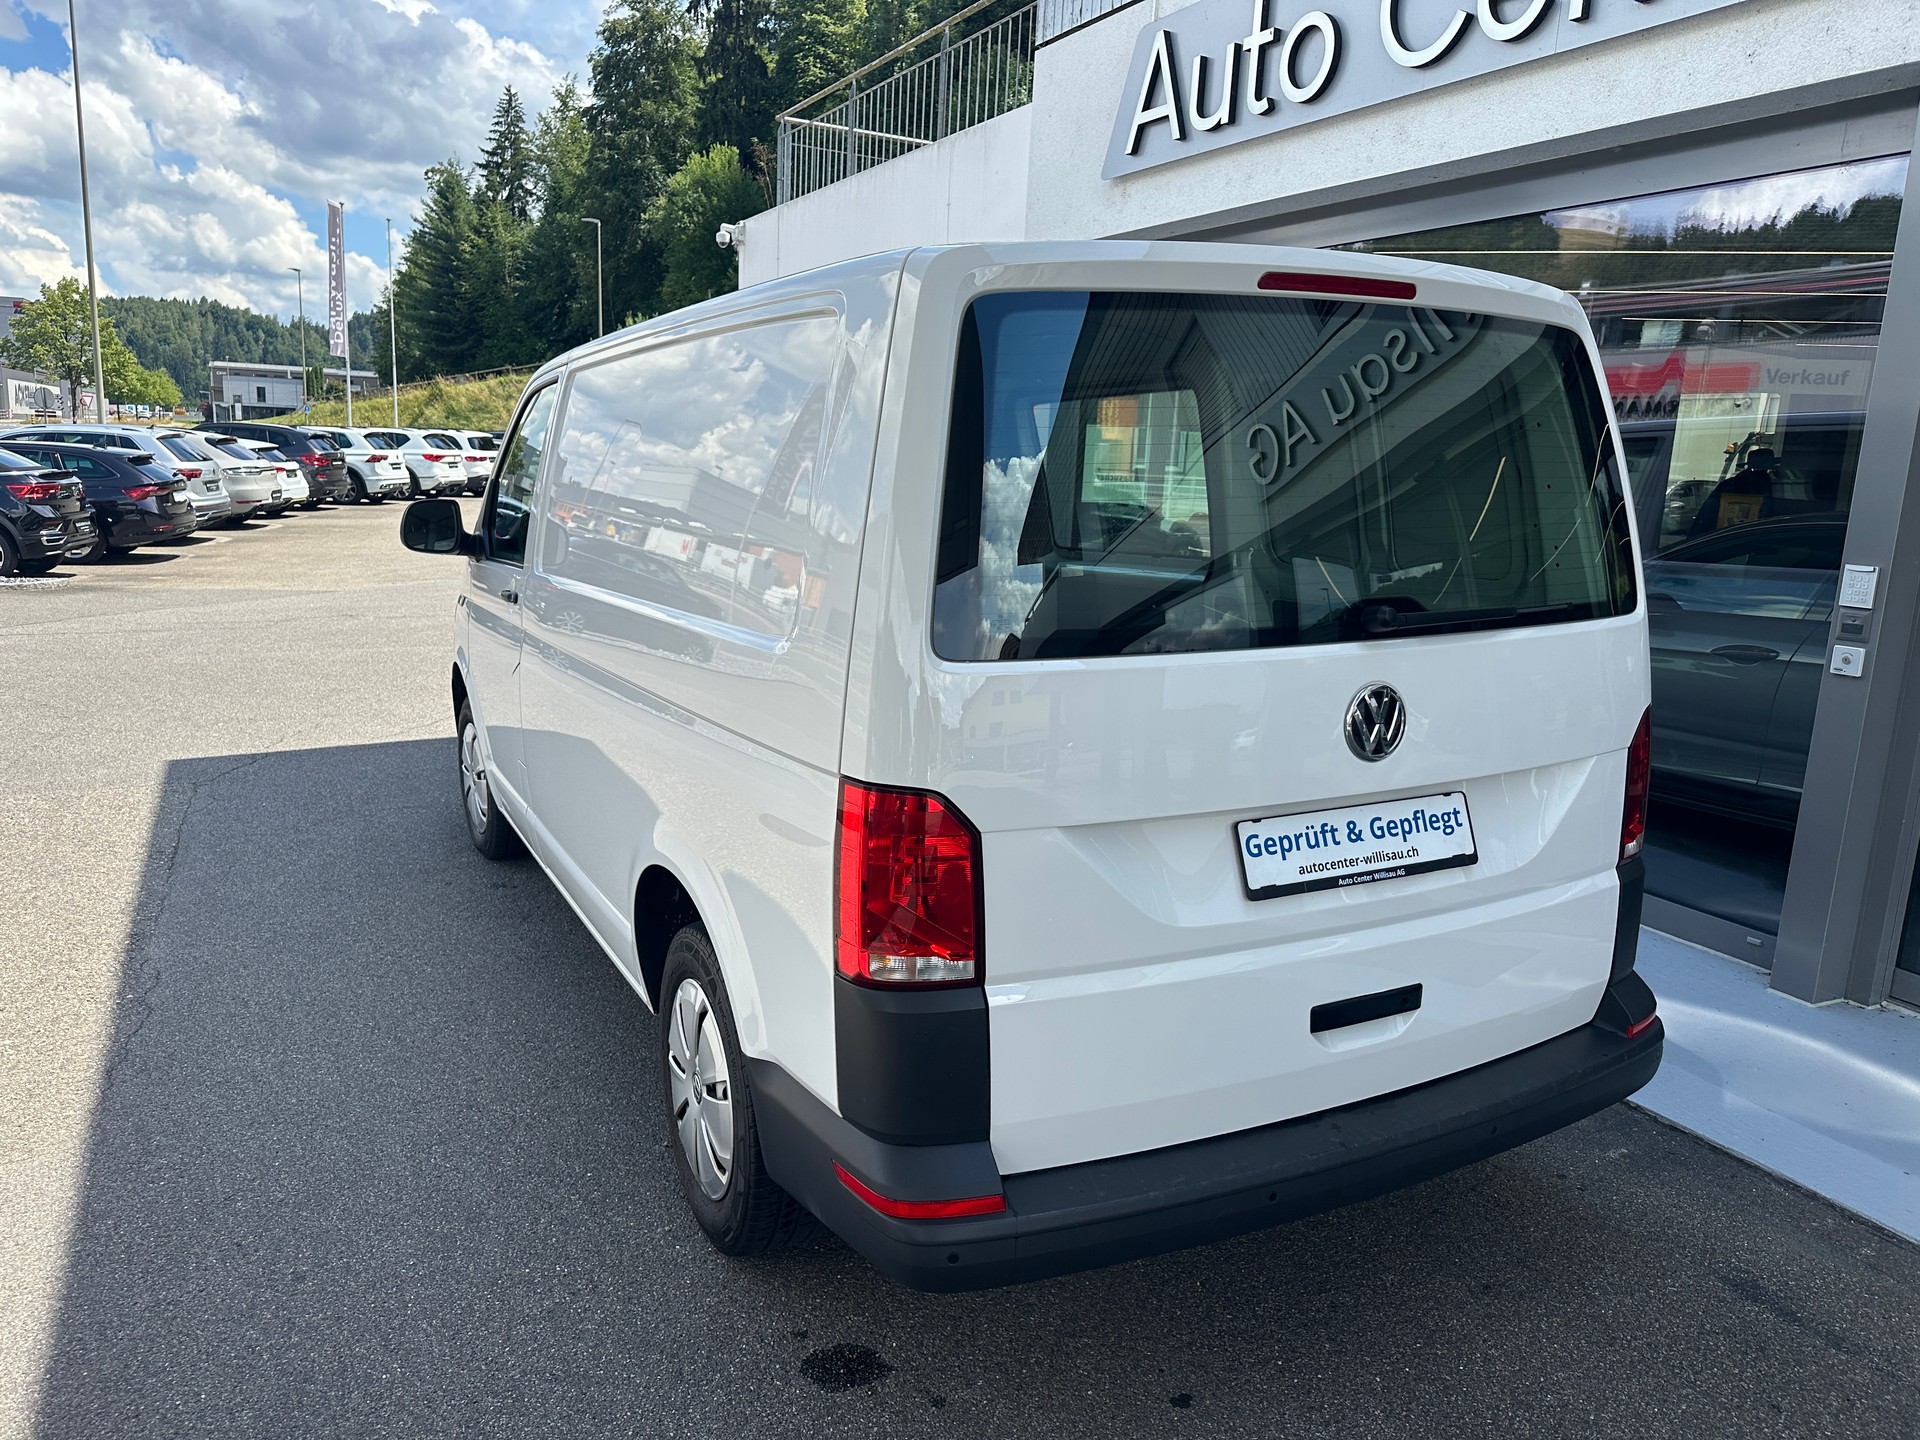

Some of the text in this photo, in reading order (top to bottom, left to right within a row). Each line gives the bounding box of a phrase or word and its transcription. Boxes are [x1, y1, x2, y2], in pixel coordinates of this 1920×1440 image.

[1124, 0, 1343, 156] Auto
[1766, 367, 1851, 386] Verkauf
[1245, 807, 1463, 861] Geprüft & Gepflegt
[1298, 846, 1419, 875] autocenter-willisau.ch
[1338, 868, 1406, 886] Auto Center Willisau AG
